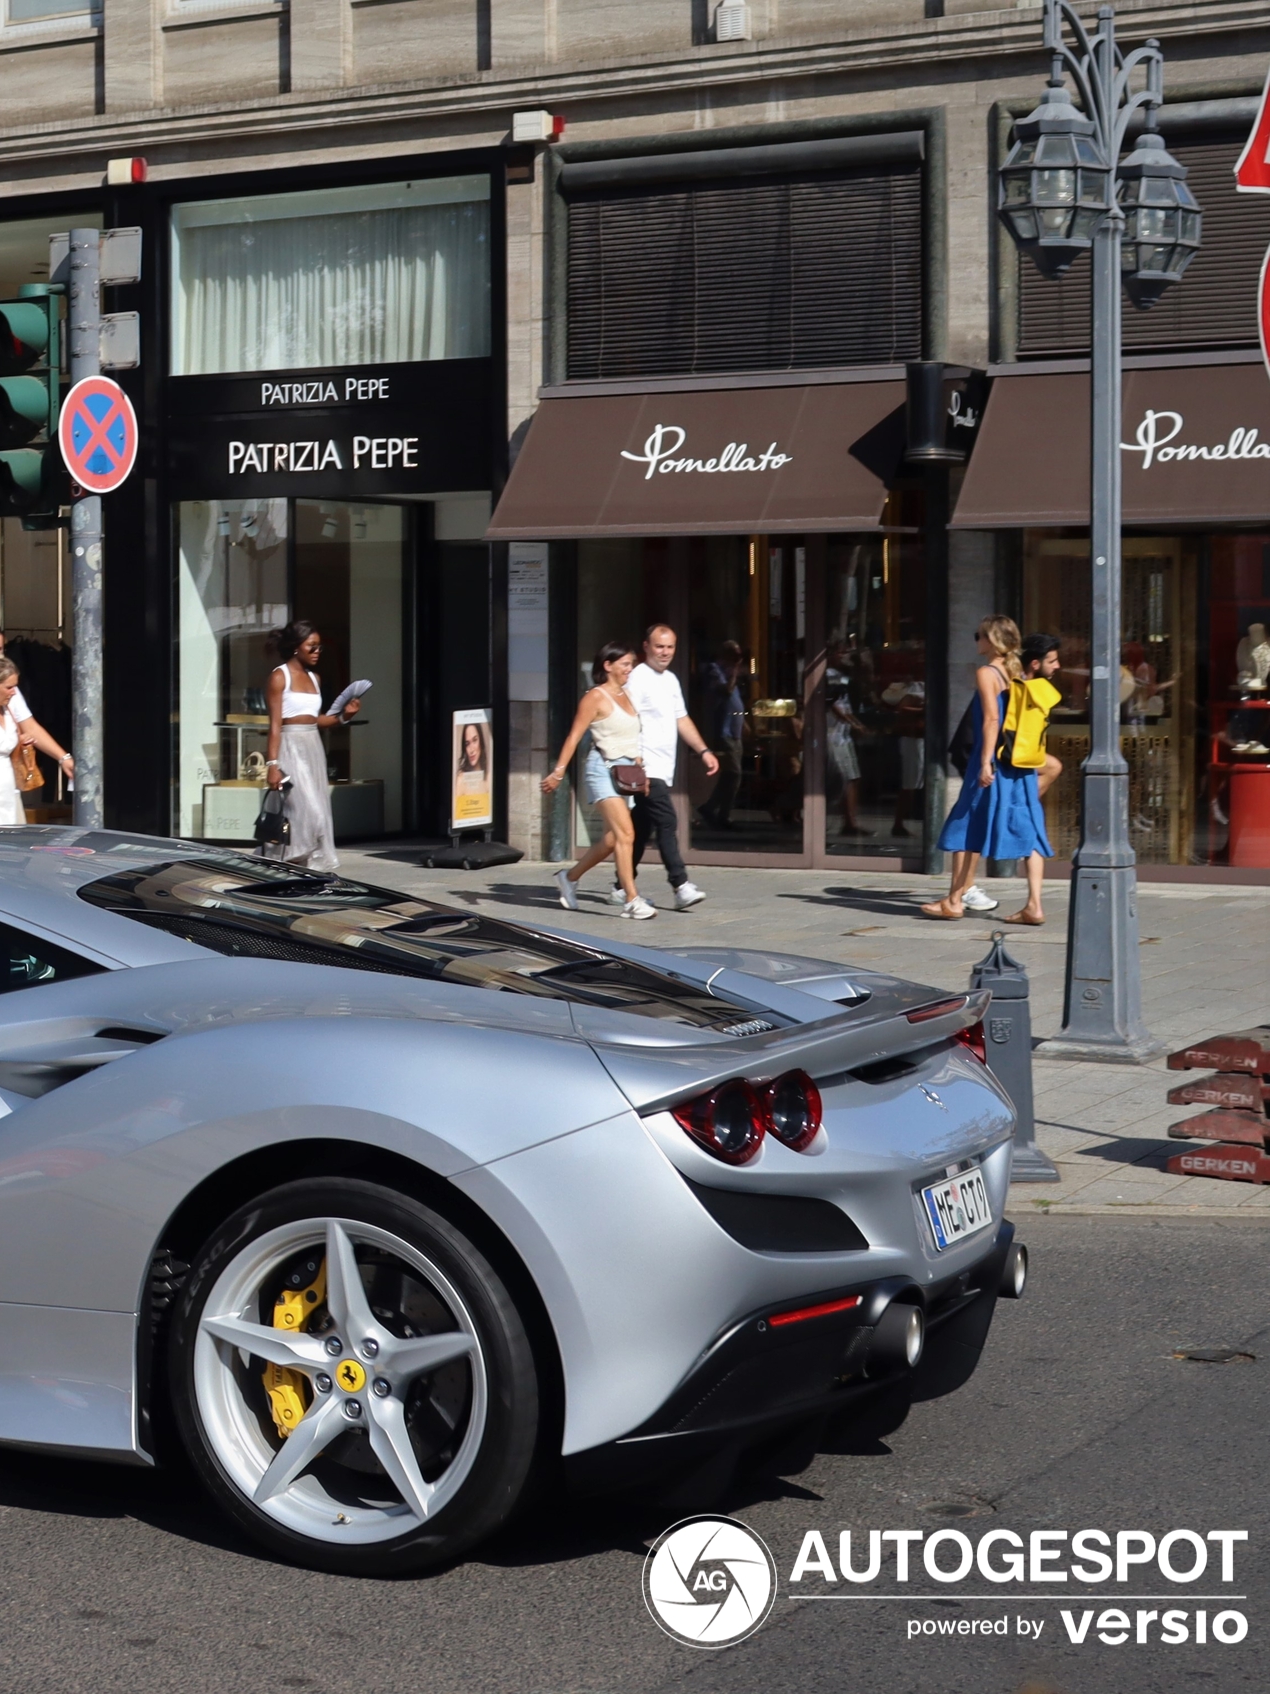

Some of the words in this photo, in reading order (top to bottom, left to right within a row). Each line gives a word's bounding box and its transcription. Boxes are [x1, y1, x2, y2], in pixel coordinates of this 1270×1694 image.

[261, 380, 339, 406] PATRIZIA
[345, 377, 390, 400] PEPE
[228, 438, 343, 474] PATRIZIA
[352, 435, 419, 470] PEPE
[620, 423, 793, 480] Pomellato
[1181, 1088, 1255, 1105] GERKEN
[1180, 1156, 1257, 1174] GERKEN
[934, 1189, 960, 1237] ME
